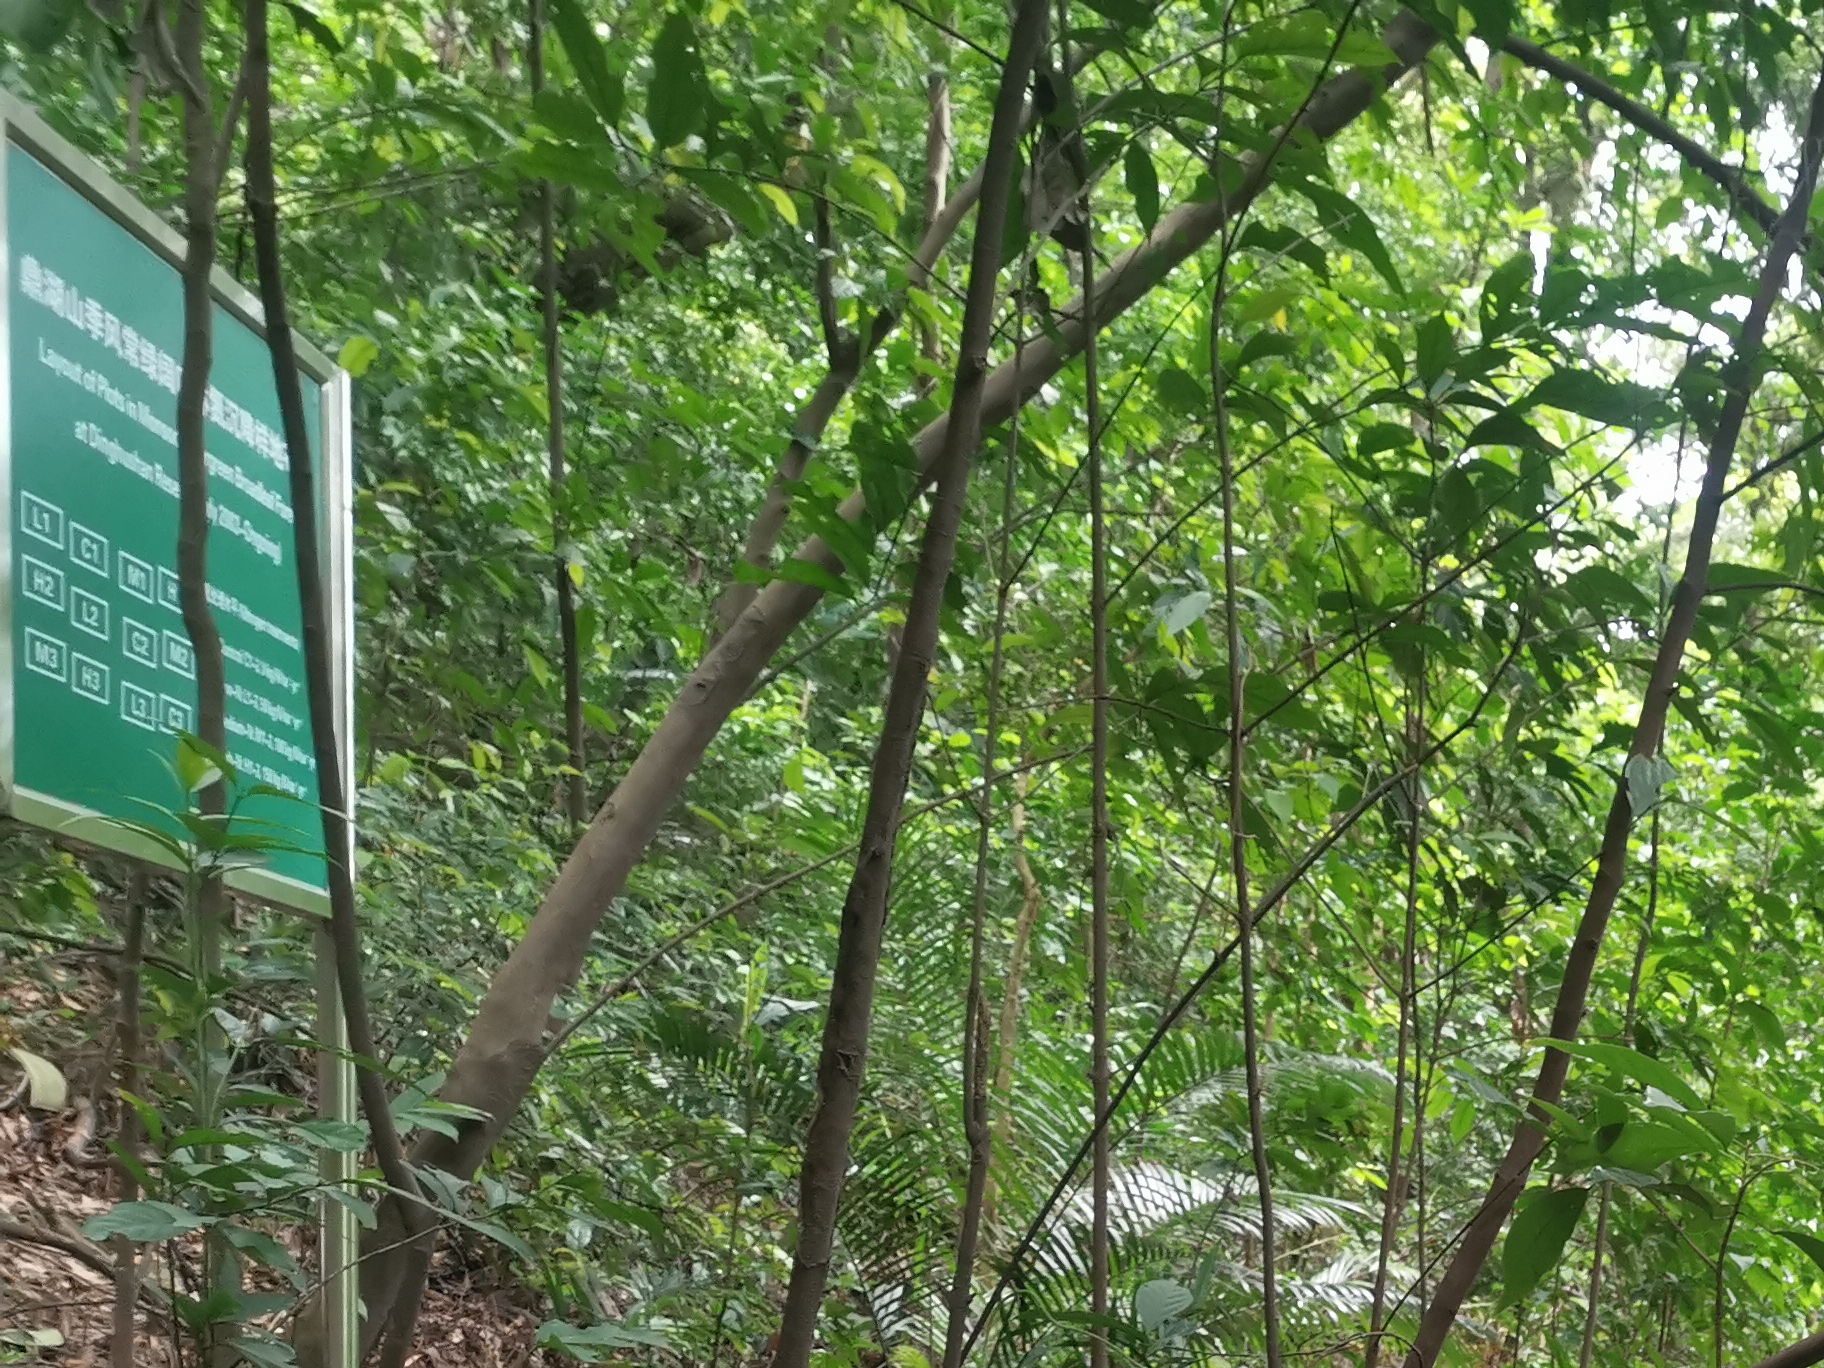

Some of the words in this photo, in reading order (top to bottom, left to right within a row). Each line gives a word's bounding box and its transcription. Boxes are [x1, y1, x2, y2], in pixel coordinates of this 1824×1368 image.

[37, 336, 84, 386] Layout
[97, 373, 126, 412] Plots
[74, 420, 88, 444] at
[31, 506, 50, 533] L1
[81, 537, 99, 564] C1
[33, 568, 55, 598] H2
[128, 564, 146, 592] M1
[82, 600, 99, 627] L2
[34, 641, 58, 669] M3
[131, 631, 149, 657] C2
[169, 641, 189, 669] M2
[82, 665, 100, 692] H3
[131, 693, 146, 718] L3
[168, 706, 184, 728] C3
